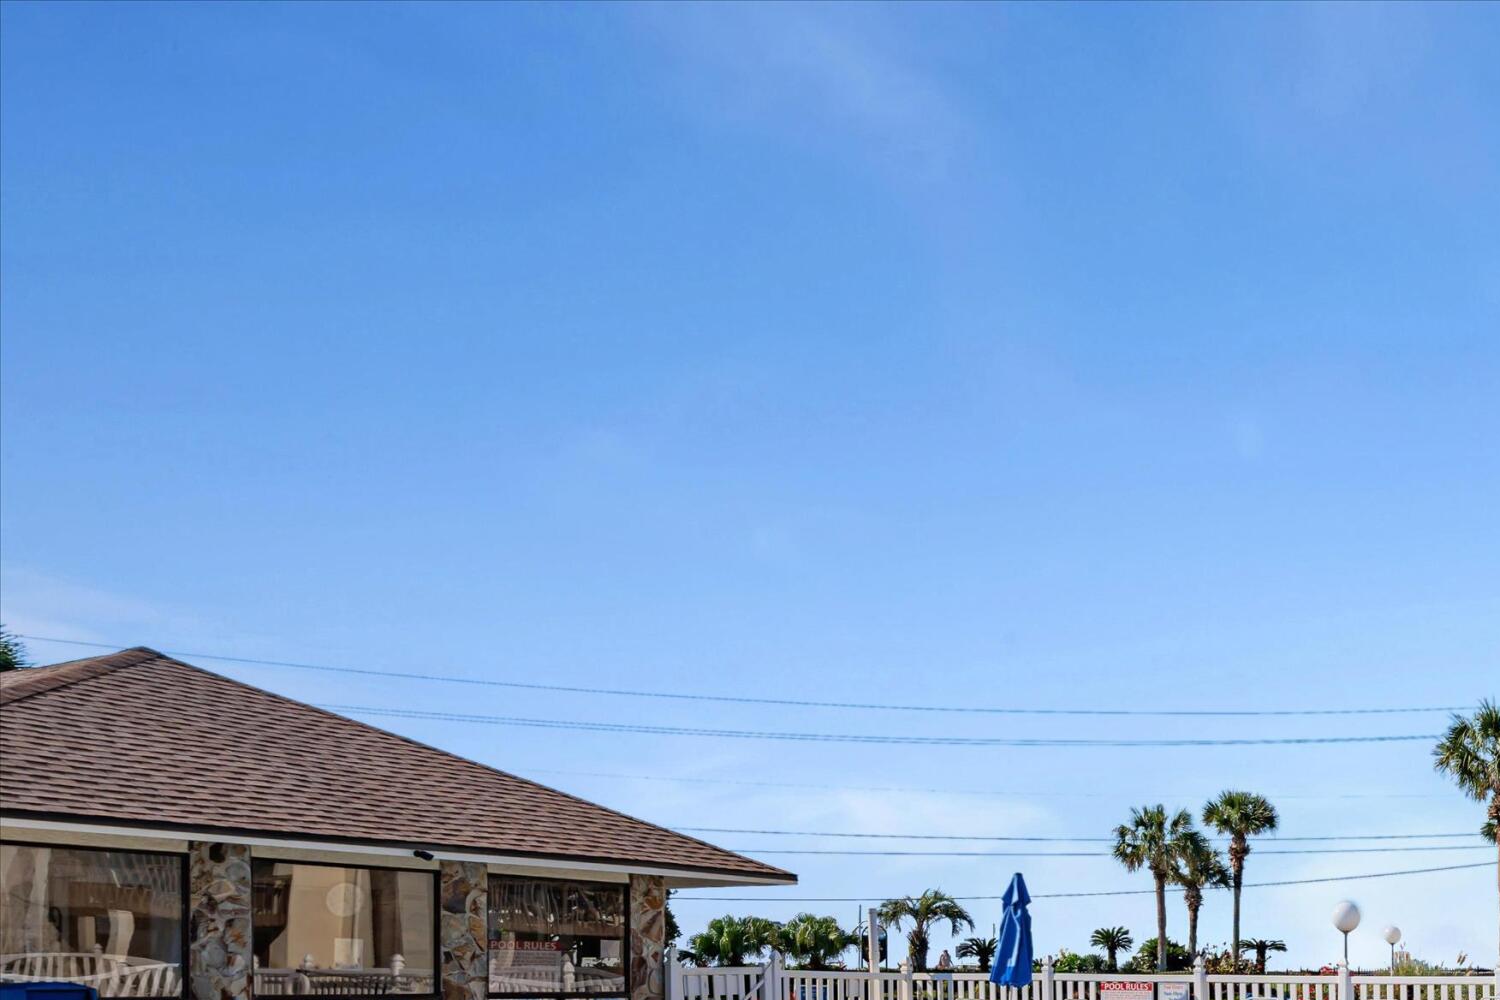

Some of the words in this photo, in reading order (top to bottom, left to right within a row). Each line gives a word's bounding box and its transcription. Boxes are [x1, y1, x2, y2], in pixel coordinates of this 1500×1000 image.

[490, 941, 521, 950] POOL
[523, 941, 557, 951] RULES
[1105, 983, 1124, 991] POOL
[1126, 983, 1149, 991] RULES
